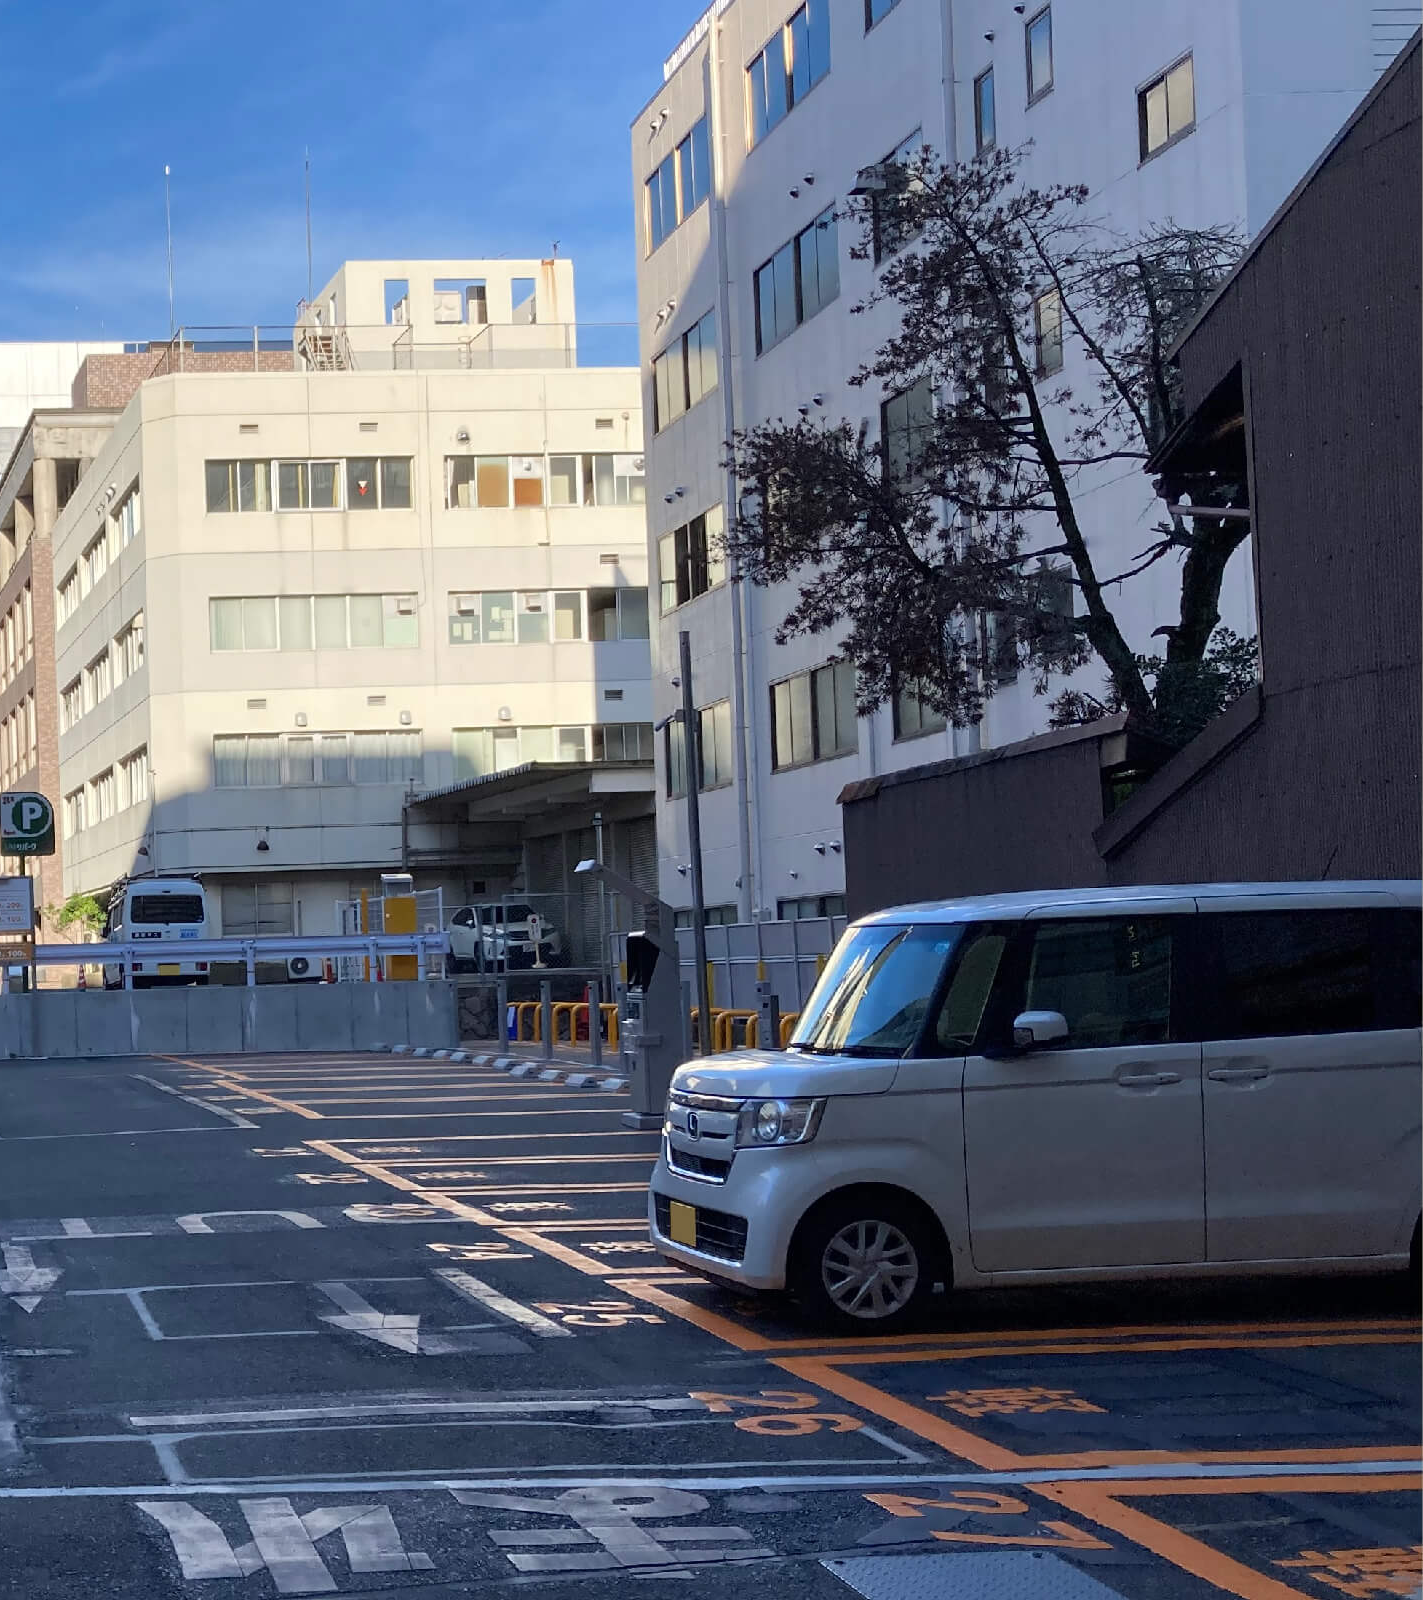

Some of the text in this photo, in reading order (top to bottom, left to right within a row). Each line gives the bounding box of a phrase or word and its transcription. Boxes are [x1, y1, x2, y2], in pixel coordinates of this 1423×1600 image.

[22, 802, 43, 830] P
[532, 1301, 667, 1328] 25
[689, 1390, 865, 1436] 26
[864, 1490, 1114, 1551] 27
